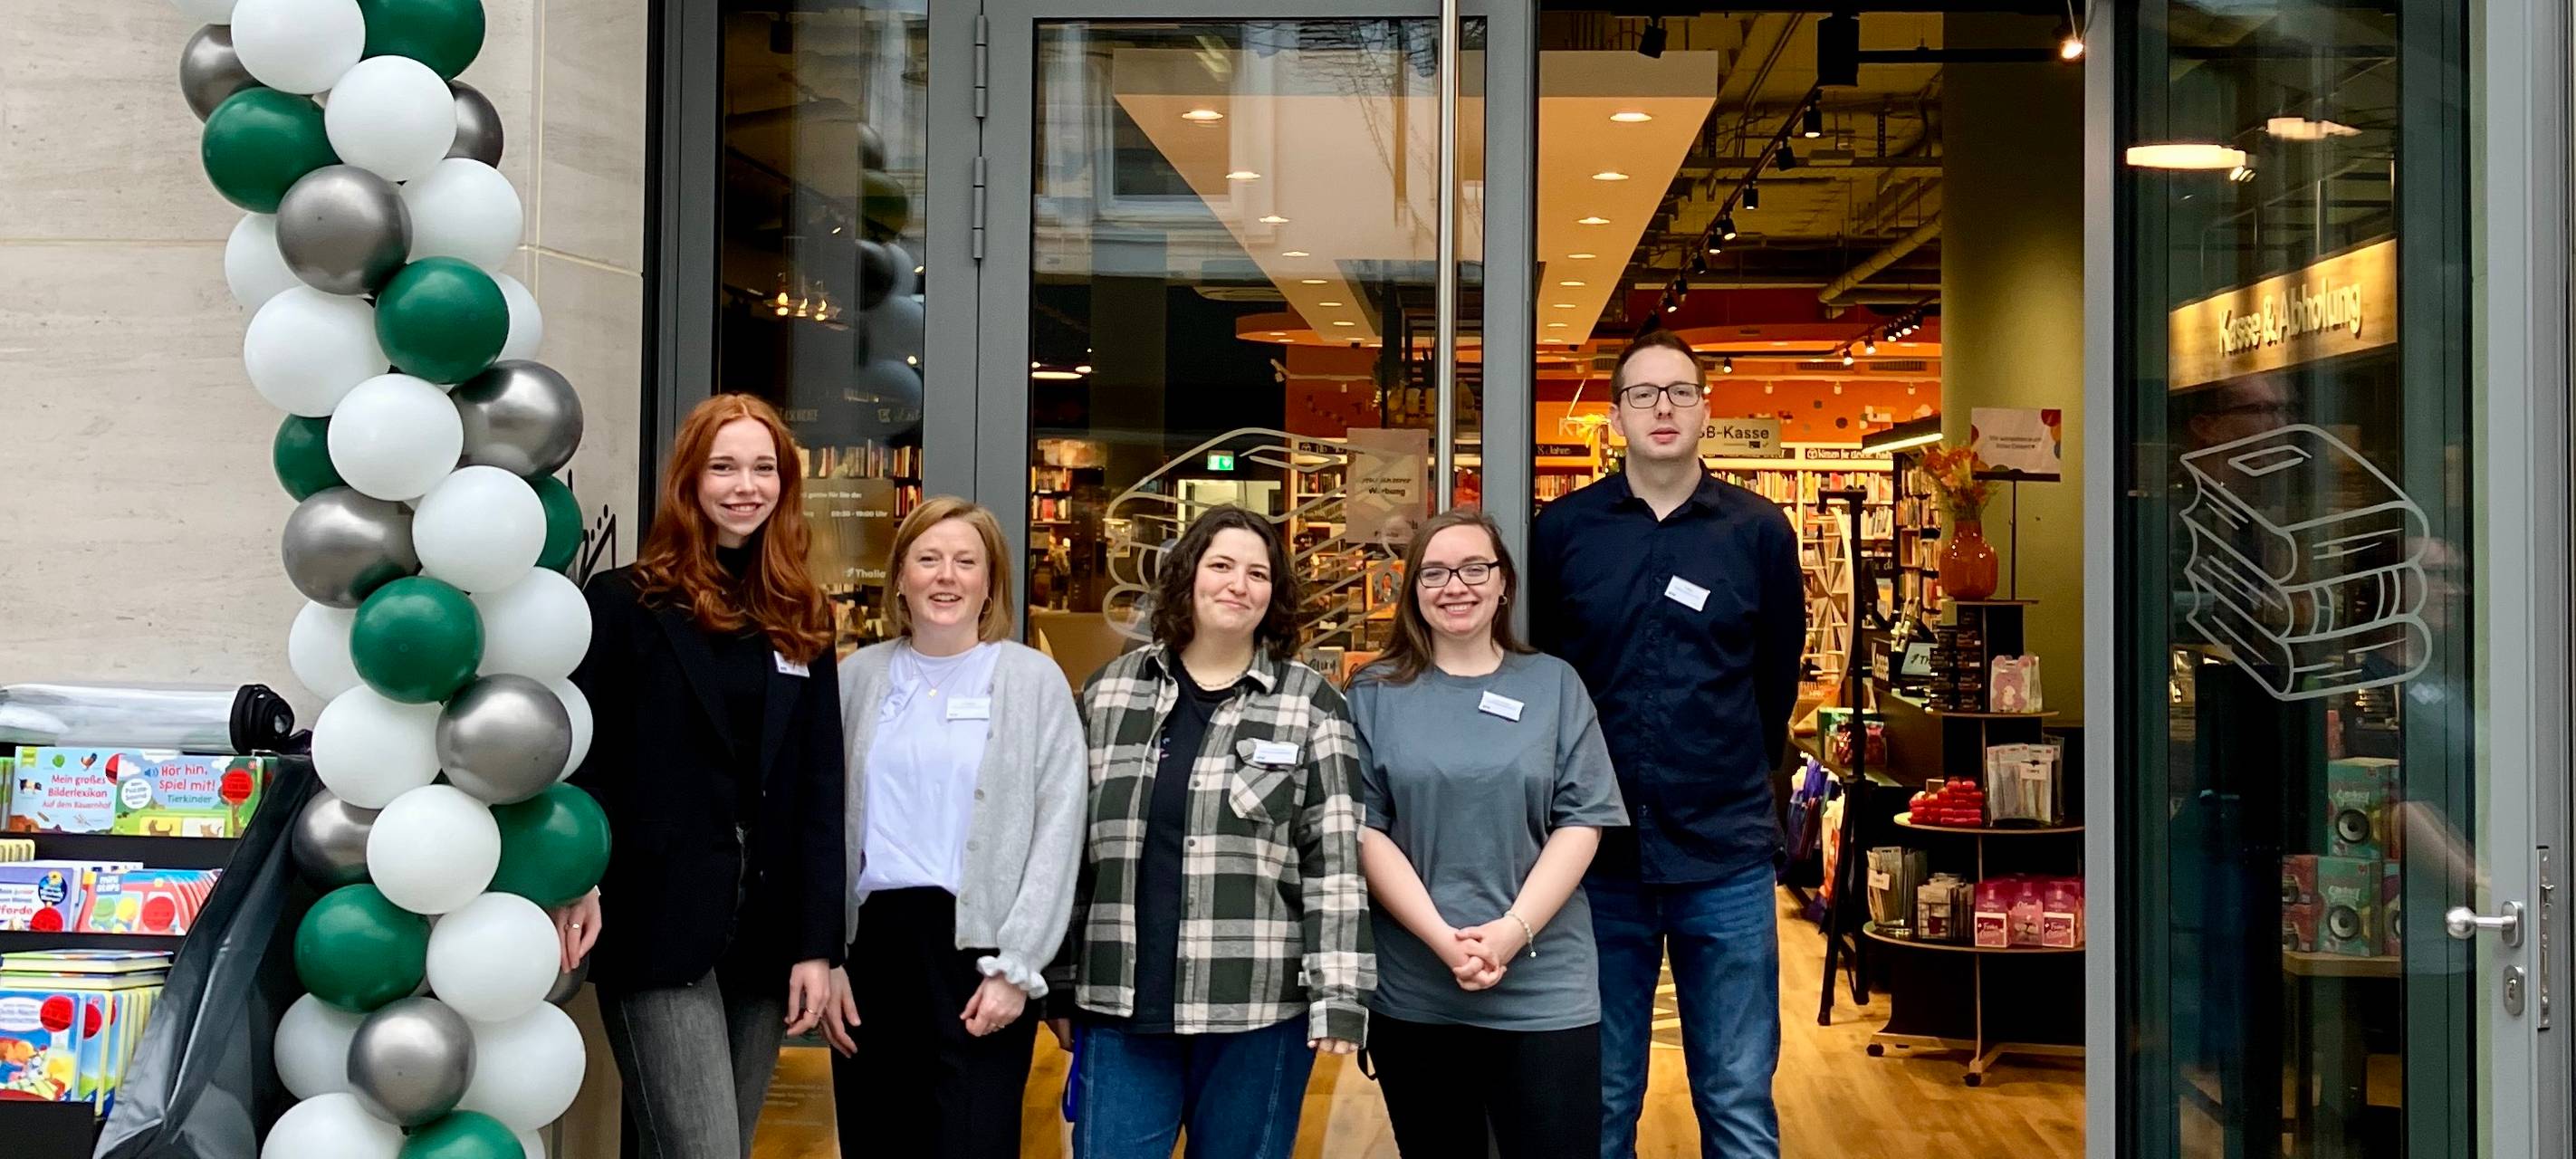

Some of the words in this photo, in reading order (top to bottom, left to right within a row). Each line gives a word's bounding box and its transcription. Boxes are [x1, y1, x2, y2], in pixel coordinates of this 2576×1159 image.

[2218, 309, 2261, 354] Kasse
[2263, 294, 2278, 344] &
[2279, 277, 2361, 340] Abholung
[1368, 486, 1406, 497] Wrbung
[855, 568, 886, 580] Thalia
[161, 763, 180, 776] Hör
[51, 773, 73, 784] Mein
[74, 773, 106, 786] großes
[190, 780, 215, 791] mit!
[48, 786, 108, 798] Bilderlexikon
[43, 800, 54, 809] Auf
[56, 800, 72, 809] dem
[167, 793, 213, 804] Tierkinder
